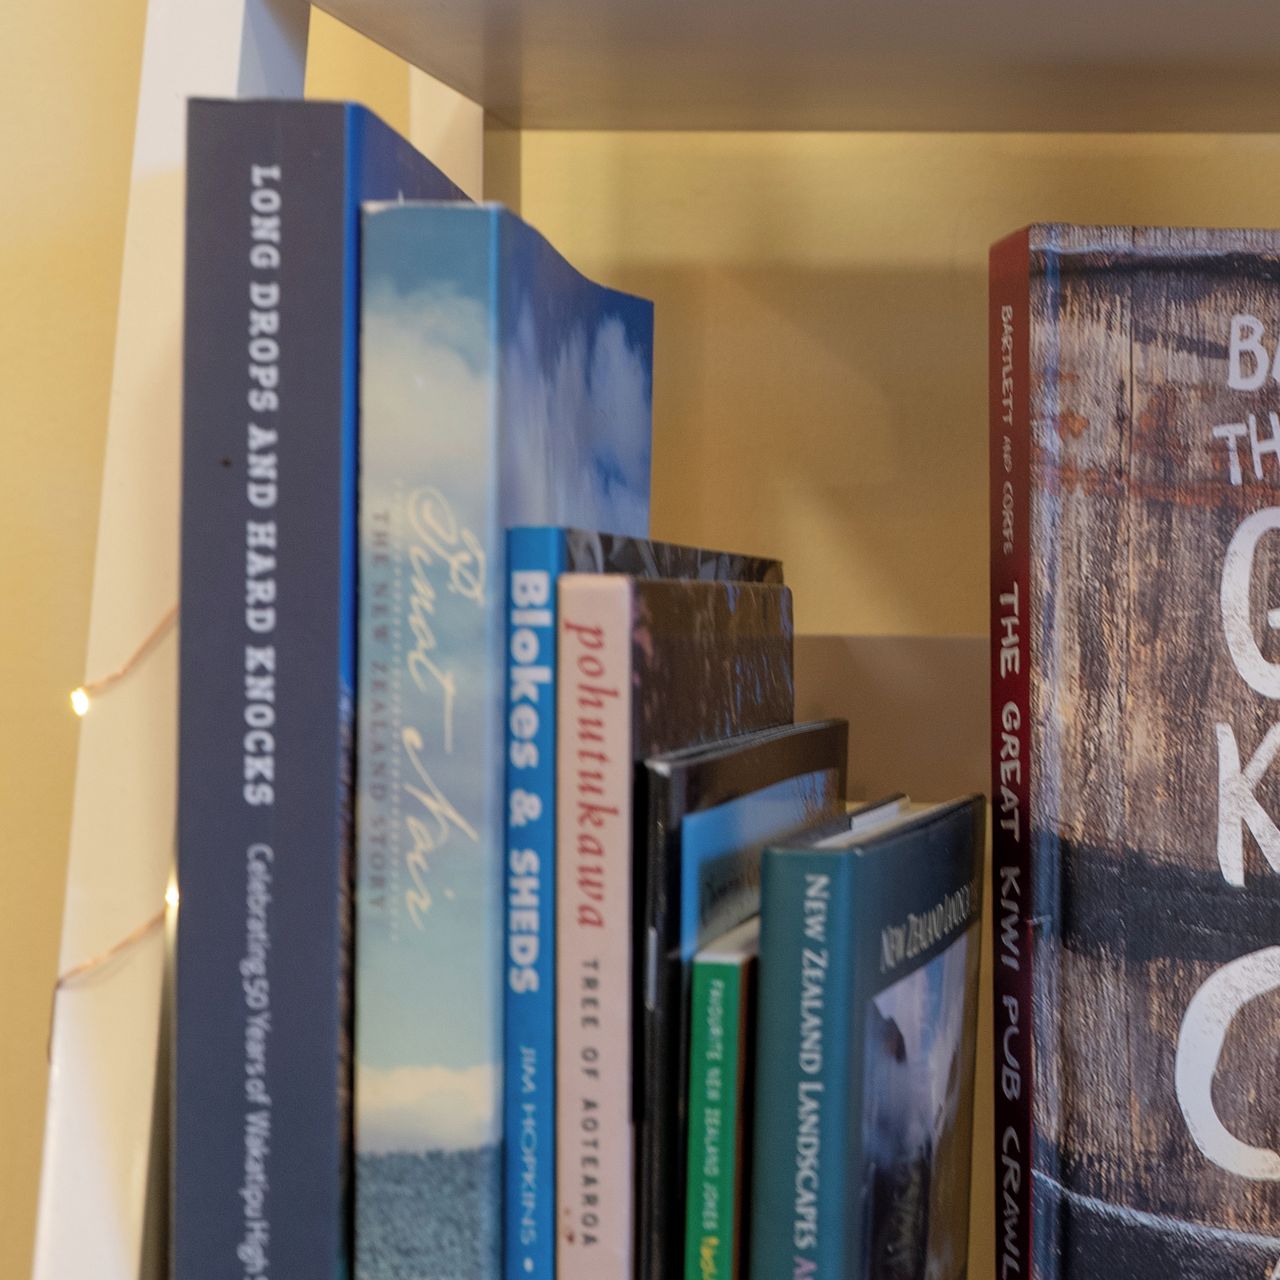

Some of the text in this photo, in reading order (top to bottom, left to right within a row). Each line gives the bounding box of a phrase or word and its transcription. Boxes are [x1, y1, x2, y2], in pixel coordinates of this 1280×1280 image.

[1000, 304, 1013, 427] BARTLETT
[243, 163, 281, 807] LONG DROPS AND HARD KNOCKS
[1002, 481, 1014, 556] CORFE
[999, 580, 1020, 680] THE
[368, 510, 391, 911] THE NEW ZEALAND STORY
[402, 487, 488, 931] Pinot Noir
[1000, 699, 1022, 842] GREAT
[508, 568, 552, 996] Blokes & SHEDS
[565, 619, 620, 930] pohutukawa
[239, 842, 275, 976] Celebrating
[802, 872, 831, 942] NEW
[1000, 865, 1021, 971] KIWI
[242, 976, 271, 1010] 50
[243, 1011, 274, 1076] Years
[799, 945, 831, 1075] ZEALAND
[1001, 995, 1022, 1101] PUB
[245, 1077, 273, 1108] of
[519, 1043, 538, 1094] JIM
[579, 960, 601, 1249] TREE OF AOTEAROA
[238, 1110, 272, 1218] Wakatipu
[519, 1103, 539, 1247] HOPKINS
[793, 1081, 826, 1249] LANDSCAPES
[237, 1220, 272, 1274] High
